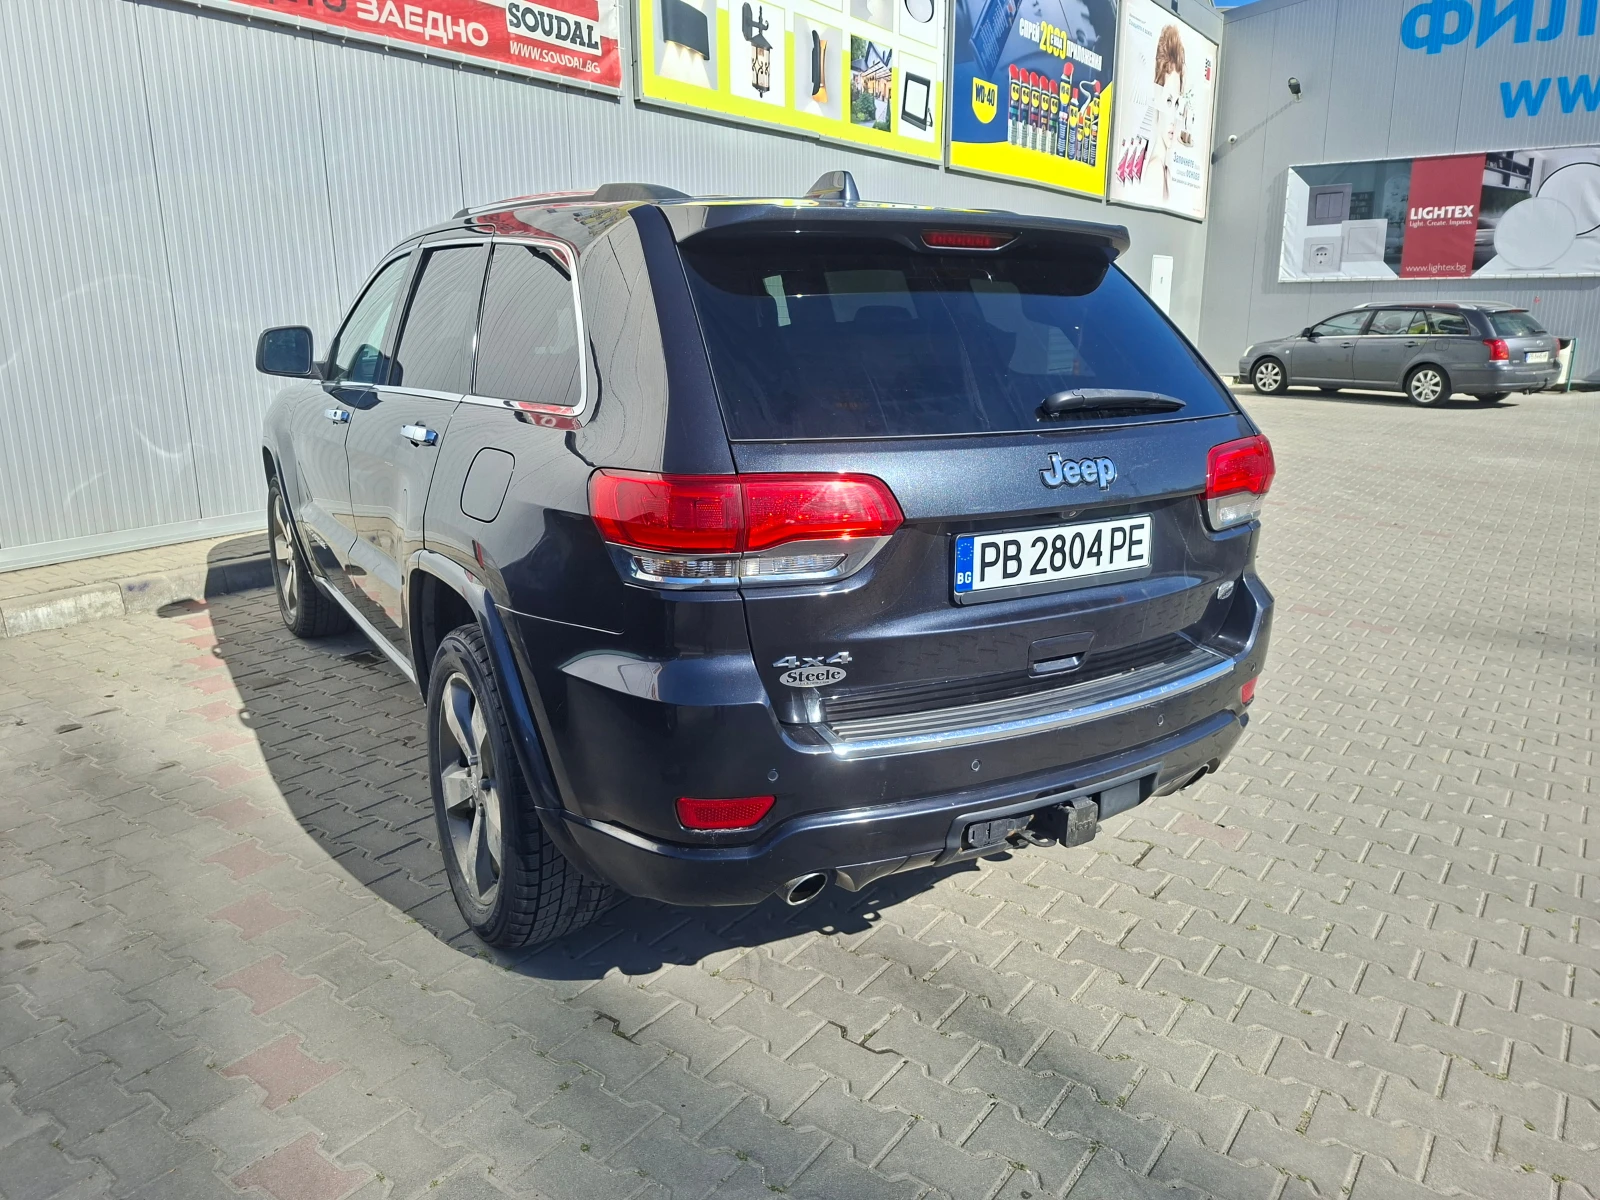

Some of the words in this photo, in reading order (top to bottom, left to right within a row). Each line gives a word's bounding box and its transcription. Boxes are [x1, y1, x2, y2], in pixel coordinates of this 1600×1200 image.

[356, 0, 489, 47] ЗАЕДНО
[507, 2, 600, 51] SOUDAL
[509, 40, 601, 74] WWW.SOUDAL.BG
[1410, 204, 1475, 220] LIGHTEX
[1409, 220, 1425, 228] Light.
[1449, 219, 1472, 227] Impress.
[1405, 262, 1467, 274] www.lightex.bg
[1040, 451, 1118, 491] Jeep
[979, 540, 1023, 582] PB
[1029, 528, 1103, 576] 2804
[1109, 523, 1146, 565] PE
[956, 571, 972, 585] BG
[772, 650, 853, 669] 4x4
[786, 669, 841, 684] Steele
